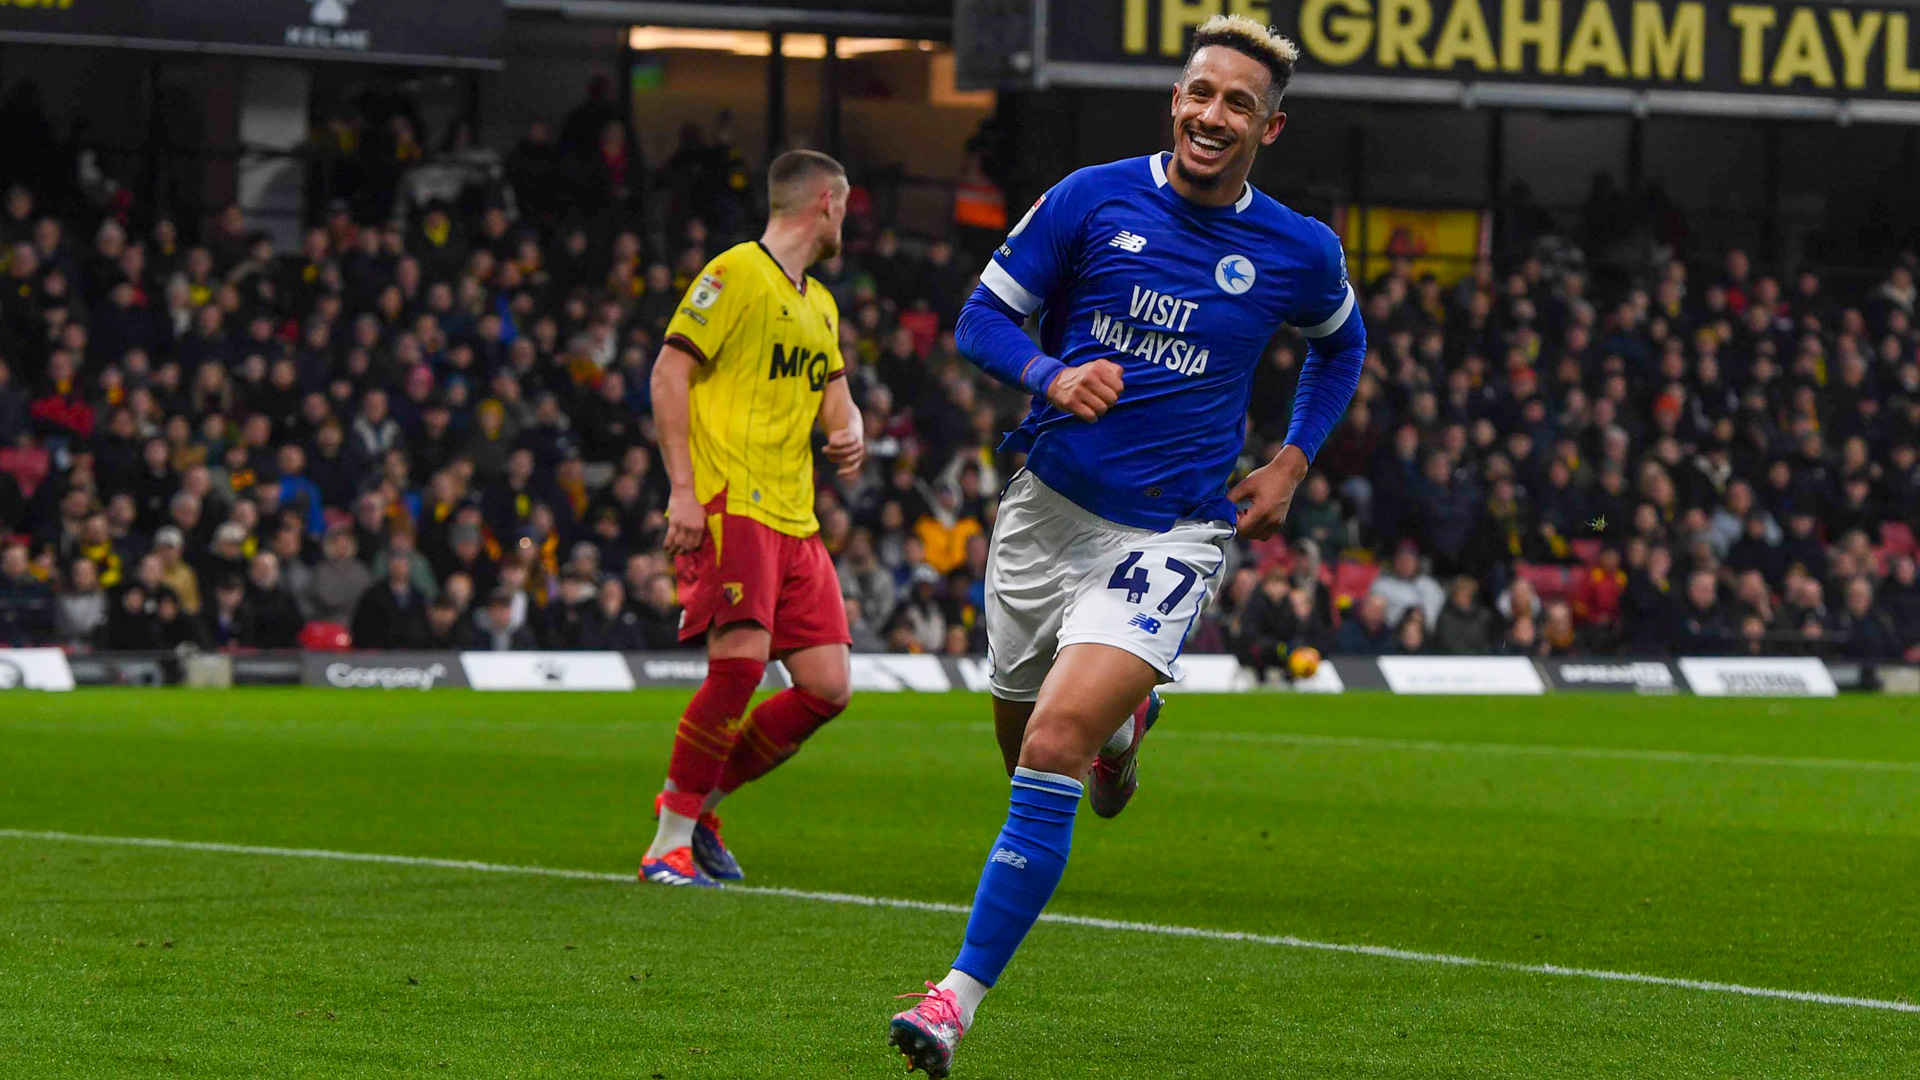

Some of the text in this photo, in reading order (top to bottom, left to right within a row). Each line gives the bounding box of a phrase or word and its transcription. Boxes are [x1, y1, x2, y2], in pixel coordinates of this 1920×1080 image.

[1301, 0, 1706, 82] GRAHAM
[1729, 5, 1920, 92] TAYL
[1128, 284, 1199, 333] VISIT
[1090, 309, 1210, 377] MALAYSIA
[1107, 551, 1198, 616] 47
